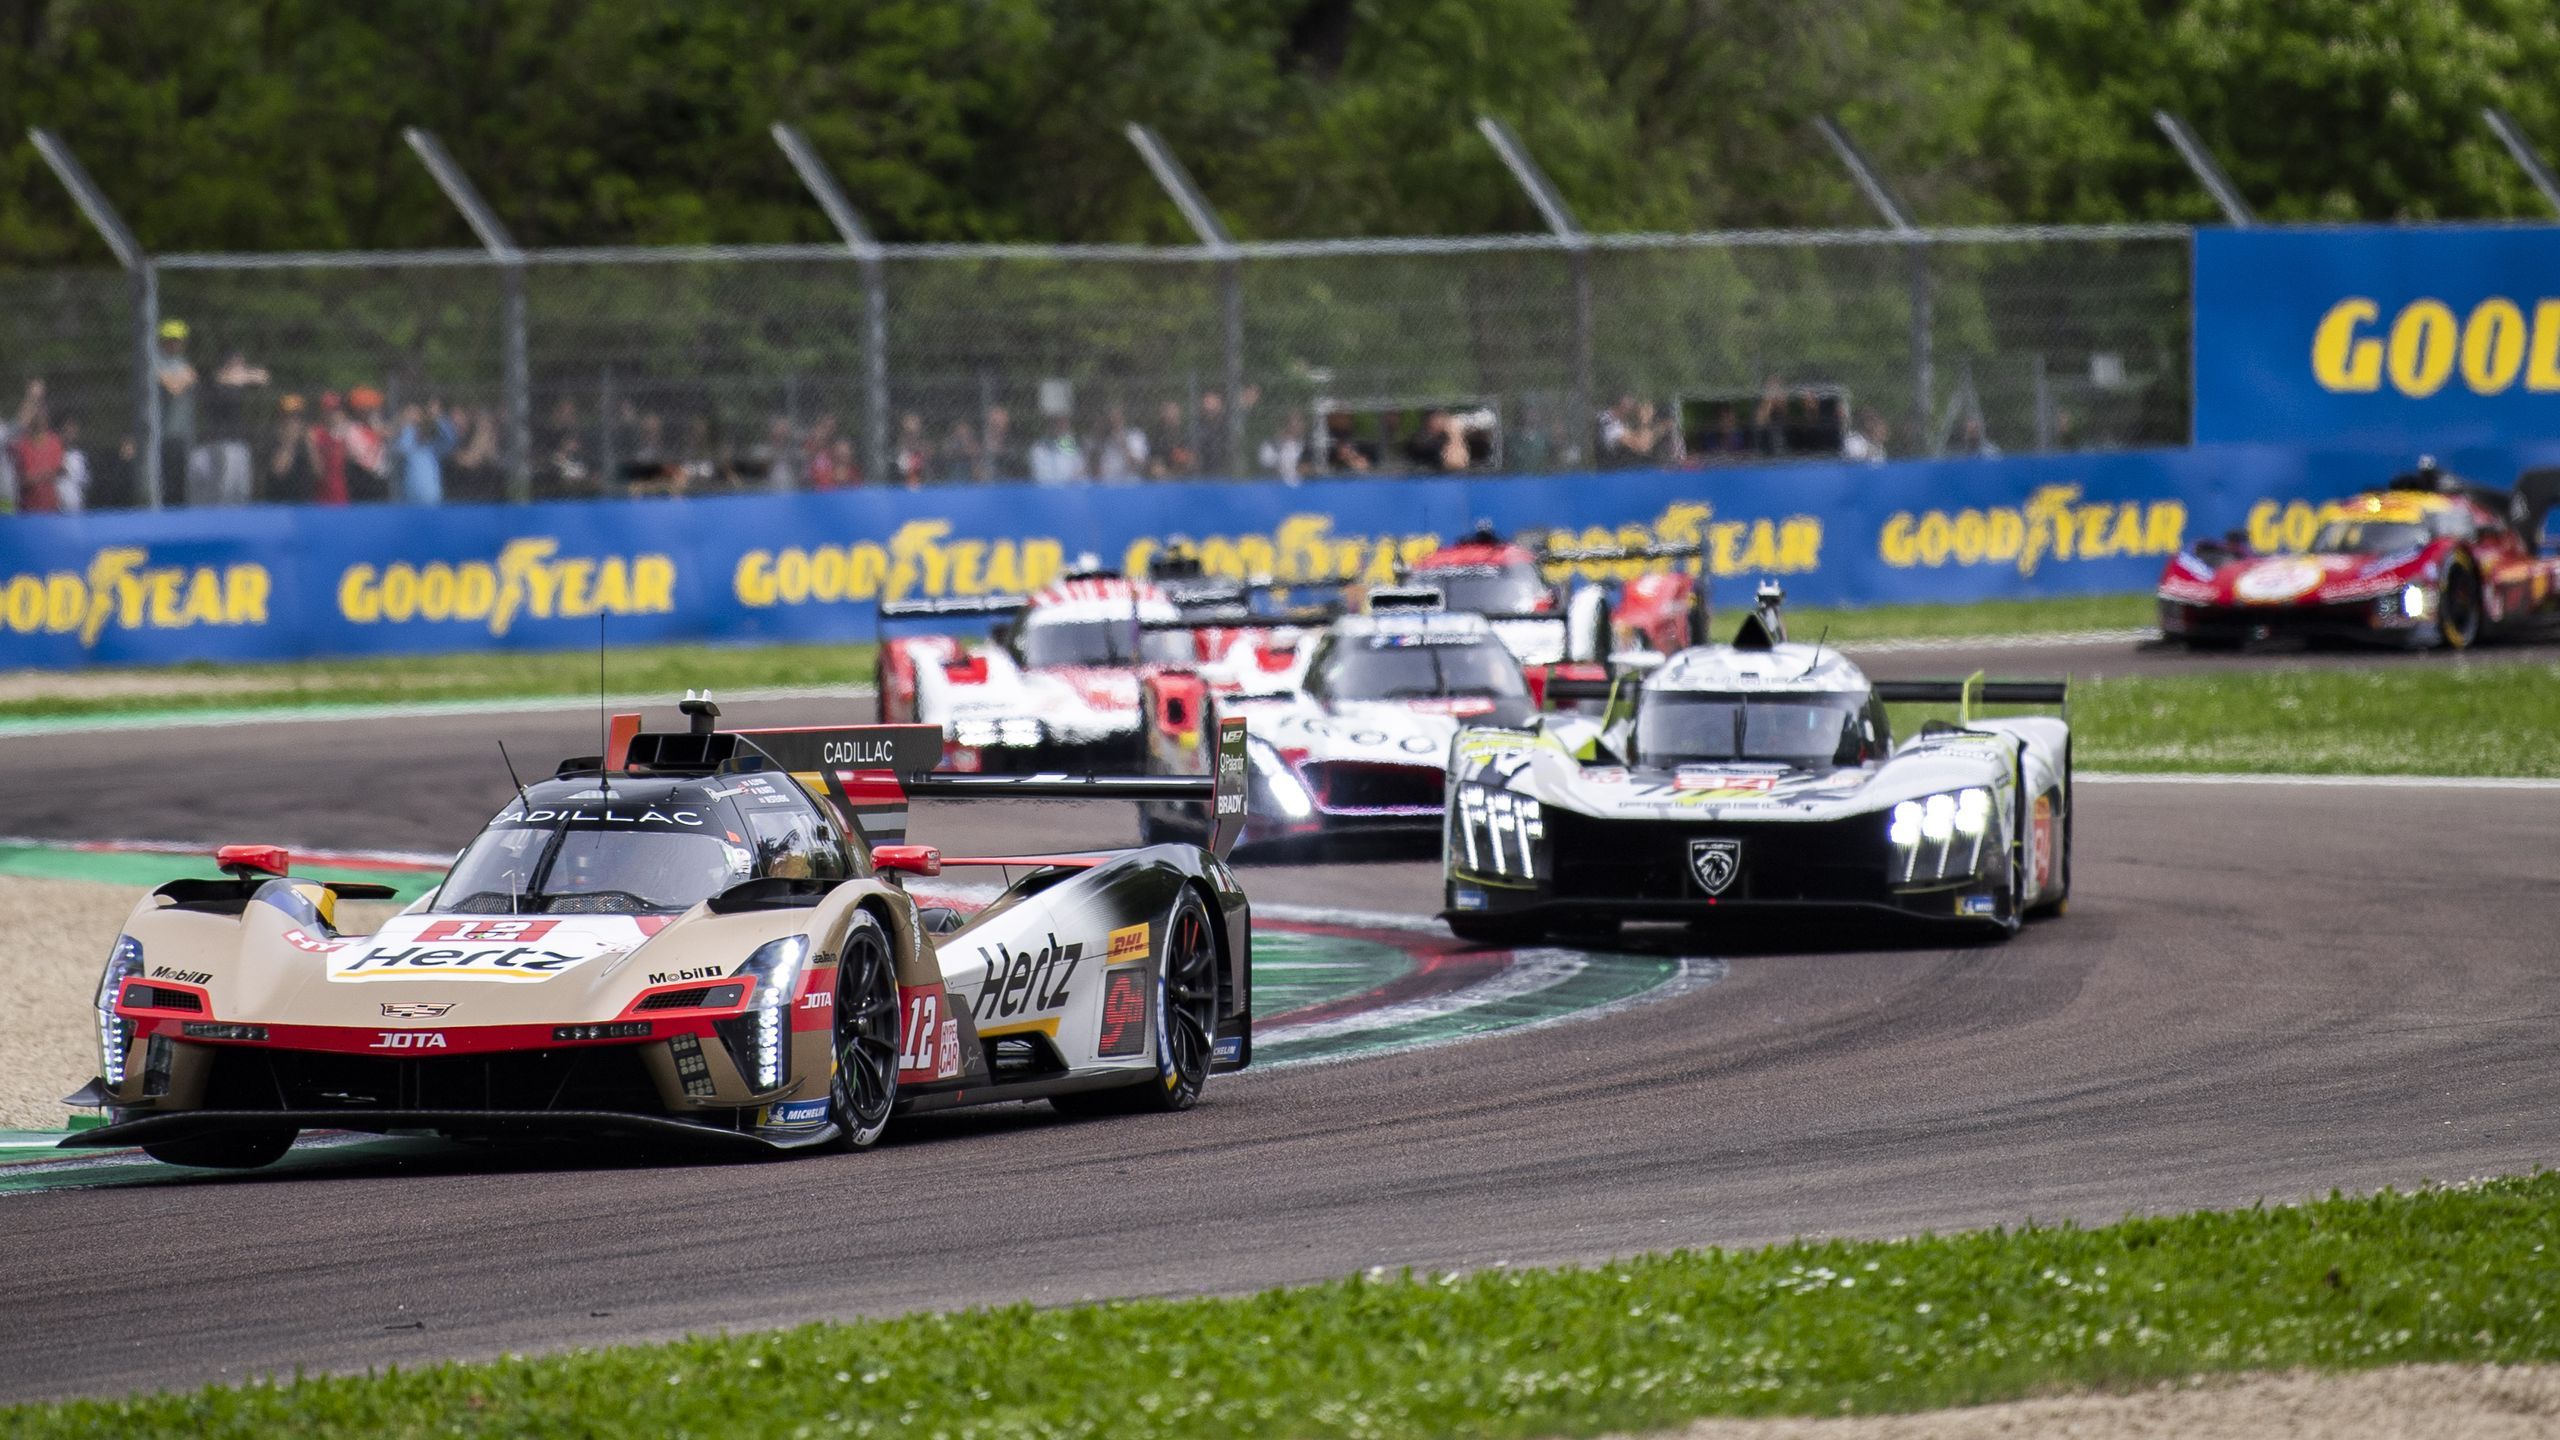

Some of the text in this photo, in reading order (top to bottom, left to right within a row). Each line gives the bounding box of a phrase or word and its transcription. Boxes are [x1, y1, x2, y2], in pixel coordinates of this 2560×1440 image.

[1879, 484, 2187, 576] GOODYEAR
[735, 519, 1063, 606] GOODYEAR
[0, 547, 271, 644] ODYEAR
[338, 537, 676, 634] GOODYEAR
[823, 740, 893, 764] CADILLAC
[1217, 794, 1243, 815] BRADY
[489, 809, 704, 827] CADILLAC
[440, 919, 525, 942] 12
[1112, 931, 1143, 951] DHL
[346, 943, 586, 971] Hertz
[151, 966, 199, 982] Mobil
[649, 967, 704, 984] Mobil
[971, 932, 1083, 1019] Hertz
[800, 992, 832, 1010] JOTA
[369, 1032, 447, 1049] JOTA
[899, 995, 937, 1071] 12
[940, 1042, 958, 1073] CAR
[786, 1106, 827, 1120] MICHELIN
